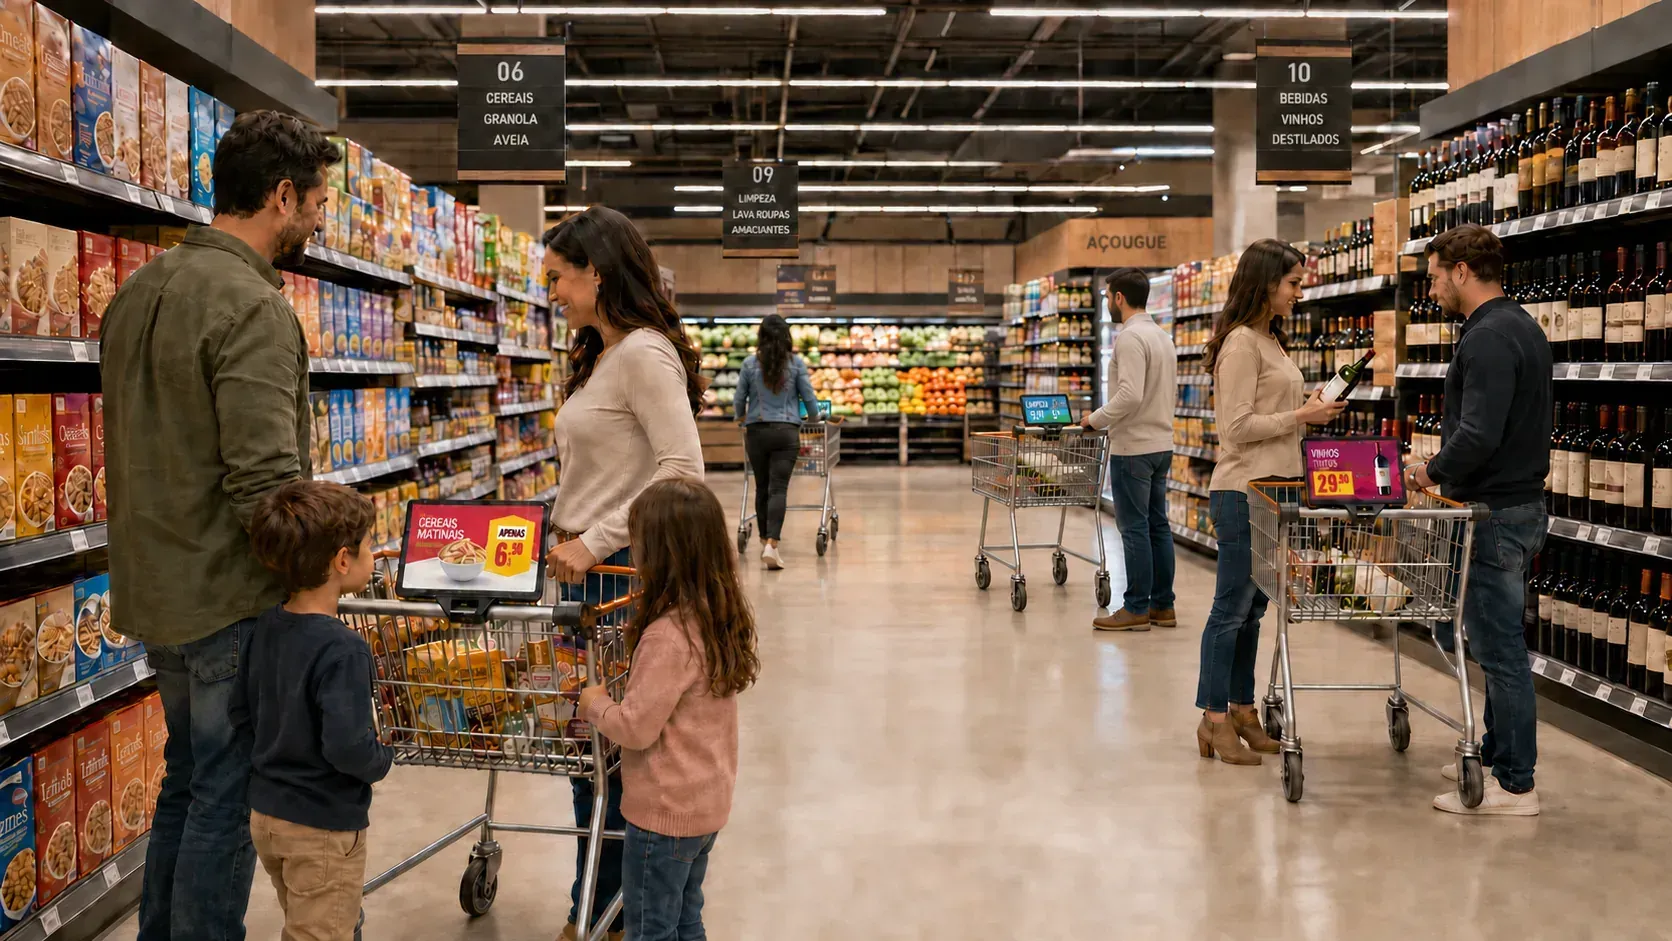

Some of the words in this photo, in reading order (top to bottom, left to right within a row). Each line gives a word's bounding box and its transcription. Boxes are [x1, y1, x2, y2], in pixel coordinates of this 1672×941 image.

[497, 61, 524, 81] 06
[1288, 62, 1311, 83] 10
[486, 92, 534, 104] CEREAIS
[1279, 92, 1328, 104] BEBIDAS
[483, 113, 538, 125] GRANOLA
[1281, 113, 1324, 125] VINHOS
[493, 134, 529, 146] AVEIA
[1272, 133, 1340, 145] DESTILADOS
[752, 166, 774, 183] 09
[738, 194, 776, 203] LIMPEZA
[732, 210, 755, 219] LAVA
[756, 210, 791, 219] ROUPAS
[731, 225, 790, 234] AMACIANTES
[1086, 235, 1167, 253] AÇOUGUE
[1310, 448, 1340, 458] VINHOS
[418, 517, 458, 528] CEREAIS
[416, 528, 465, 540] MATINAIS
[498, 528, 526, 538] APENAS
